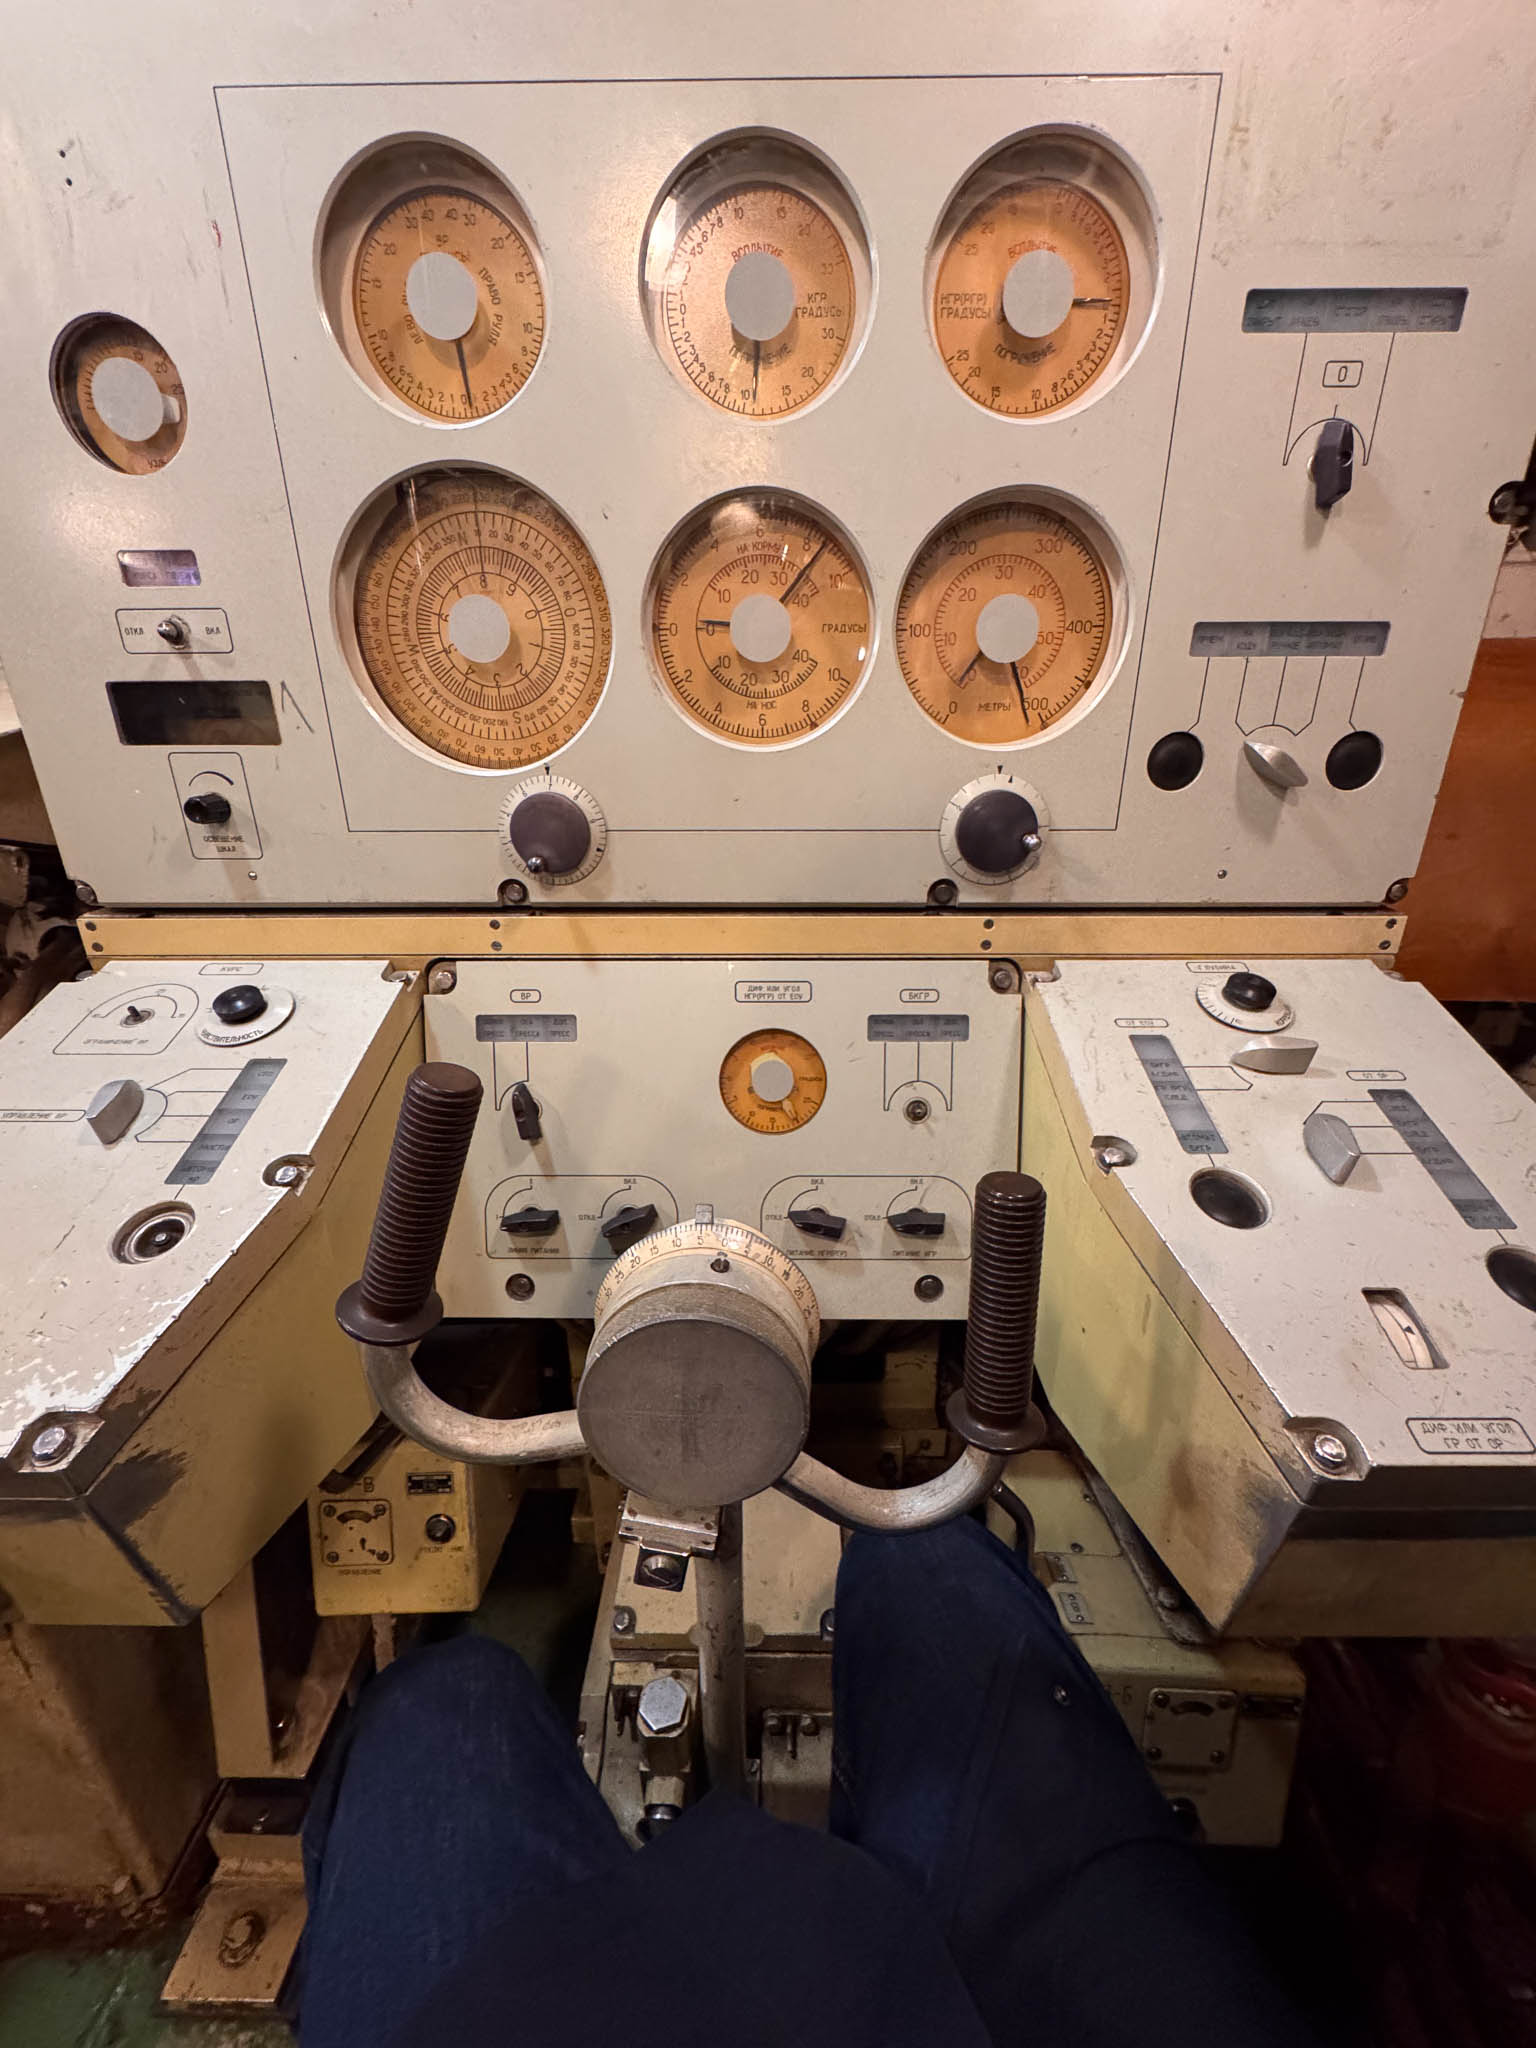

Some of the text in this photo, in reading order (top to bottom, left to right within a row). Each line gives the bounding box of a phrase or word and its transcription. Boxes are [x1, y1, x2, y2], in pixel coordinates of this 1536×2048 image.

[734, 207, 744, 220] 10
[776, 206, 786, 219] 15
[717, 216, 724, 228] 8
[710, 223, 716, 235] 7
[490, 236, 504, 250] 20
[702, 231, 708, 243] 6
[690, 246, 696, 258] 4
[696, 243, 703, 255] 5
[515, 271, 525, 284] 15
[807, 292, 828, 303] КГР
[478, 266, 503, 346] ПРАВО РУЛЯ
[681, 304, 687, 316] 0
[940, 306, 992, 320] ГРАДУСЫ
[523, 321, 533, 334] 10
[684, 331, 691, 343] 2
[822, 328, 834, 340] 30
[1097, 329, 1103, 340] 2
[689, 344, 696, 356] 3
[956, 350, 970, 362] 25
[692, 353, 699, 364] 4
[512, 363, 519, 375] 6
[699, 362, 706, 373] 5
[801, 366, 814, 378] 20
[969, 366, 982, 378] 20
[1075, 361, 1084, 371] 5
[505, 373, 513, 384] 5
[708, 371, 715, 383] 6
[1068, 370, 1075, 380] 6
[417, 381, 423, 391] 4
[491, 385, 498, 397] 3
[724, 383, 730, 394] 8
[782, 385, 792, 396] 15
[991, 386, 1001, 398] 15
[1051, 383, 1059, 393] 8
[427, 387, 434, 399] 3
[438, 391, 445, 402] 2
[461, 393, 467, 405] 0
[482, 390, 489, 402] 2
[740, 388, 750, 401] 10
[1032, 389, 1042, 400] 10
[488, 529, 498, 539] 20
[756, 525, 765, 537] 6
[504, 532, 513, 543] 30
[567, 540, 585, 561] 280
[736, 542, 782, 554] НА КОРМУ
[802, 538, 811, 551] 8
[950, 540, 977, 556] 200
[1034, 538, 1063, 554] 300
[580, 562, 597, 582] 290
[741, 569, 760, 585] 20
[995, 565, 1014, 580] 30
[480, 574, 487, 589] 8
[680, 573, 689, 587] 2
[769, 571, 788, 586] 30
[830, 574, 843, 589] 10
[506, 583, 516, 597] 9
[592, 582, 604, 603] 300
[717, 588, 731, 604] 10
[957, 587, 977, 603] 20
[1028, 585, 1046, 599] 40
[792, 593, 809, 608] 40
[525, 609, 538, 620] 0
[124, 626, 222, 635] ОТКЛ ВКЛ
[669, 624, 678, 637] 0
[821, 623, 867, 634] ГРАДУСЫ
[908, 624, 931, 638] 100
[1065, 619, 1093, 634] 400
[601, 627, 611, 645] 320
[943, 632, 957, 646] 10
[1036, 631, 1054, 645] 50
[717, 655, 731, 669] 10
[792, 649, 809, 663] 40
[684, 669, 693, 683] 2
[740, 672, 758, 687] 20
[771, 670, 790, 684] 30
[828, 668, 841, 682] 10
[967, 669, 977, 682] 0
[713, 702, 722, 714] 4
[761, 701, 777, 709] НОС
[801, 700, 810, 713] 8
[949, 701, 958, 715] 0
[977, 703, 1012, 712] МЕТРЫ
[1022, 697, 1049, 712] 500
[513, 711, 520, 724] S
[758, 714, 767, 727] 6
[456, 738, 468, 748] 70
[474, 744, 486, 753] 60
[908, 991, 930, 1000] БКГР
[672, 1237, 682, 1248] 10
[697, 1235, 704, 1245] 5
[721, 1237, 728, 1248] 0
[649, 1244, 659, 1256] 15
[630, 1256, 641, 1268] 20
[763, 1254, 773, 1266] 10
[615, 1271, 625, 1284] 25
[1443, 1438, 1460, 1449] ГР
[1465, 1438, 1482, 1449] ОТ
